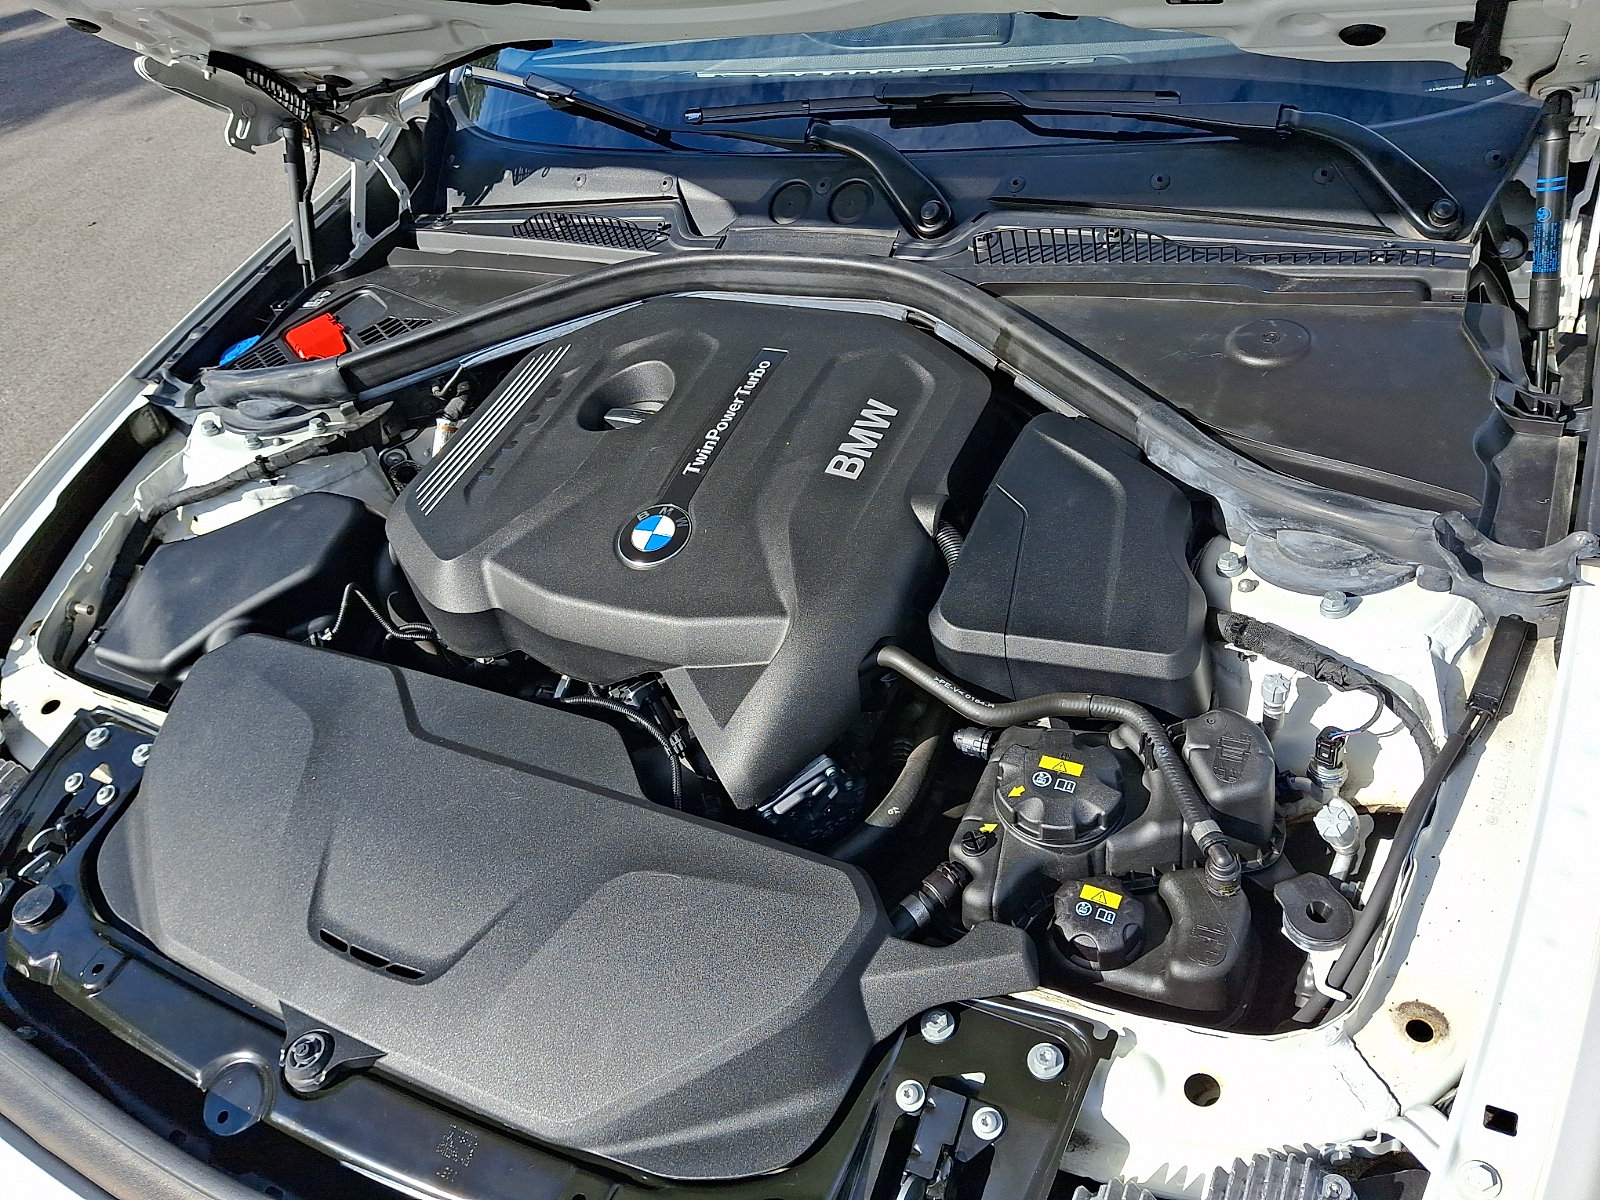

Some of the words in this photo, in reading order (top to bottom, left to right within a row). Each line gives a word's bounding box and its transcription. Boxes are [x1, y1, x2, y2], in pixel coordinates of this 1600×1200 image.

[682, 360, 771, 475] TwinPowerTurbo
[825, 398, 898, 480] BMW
[636, 507, 689, 528] BMW
